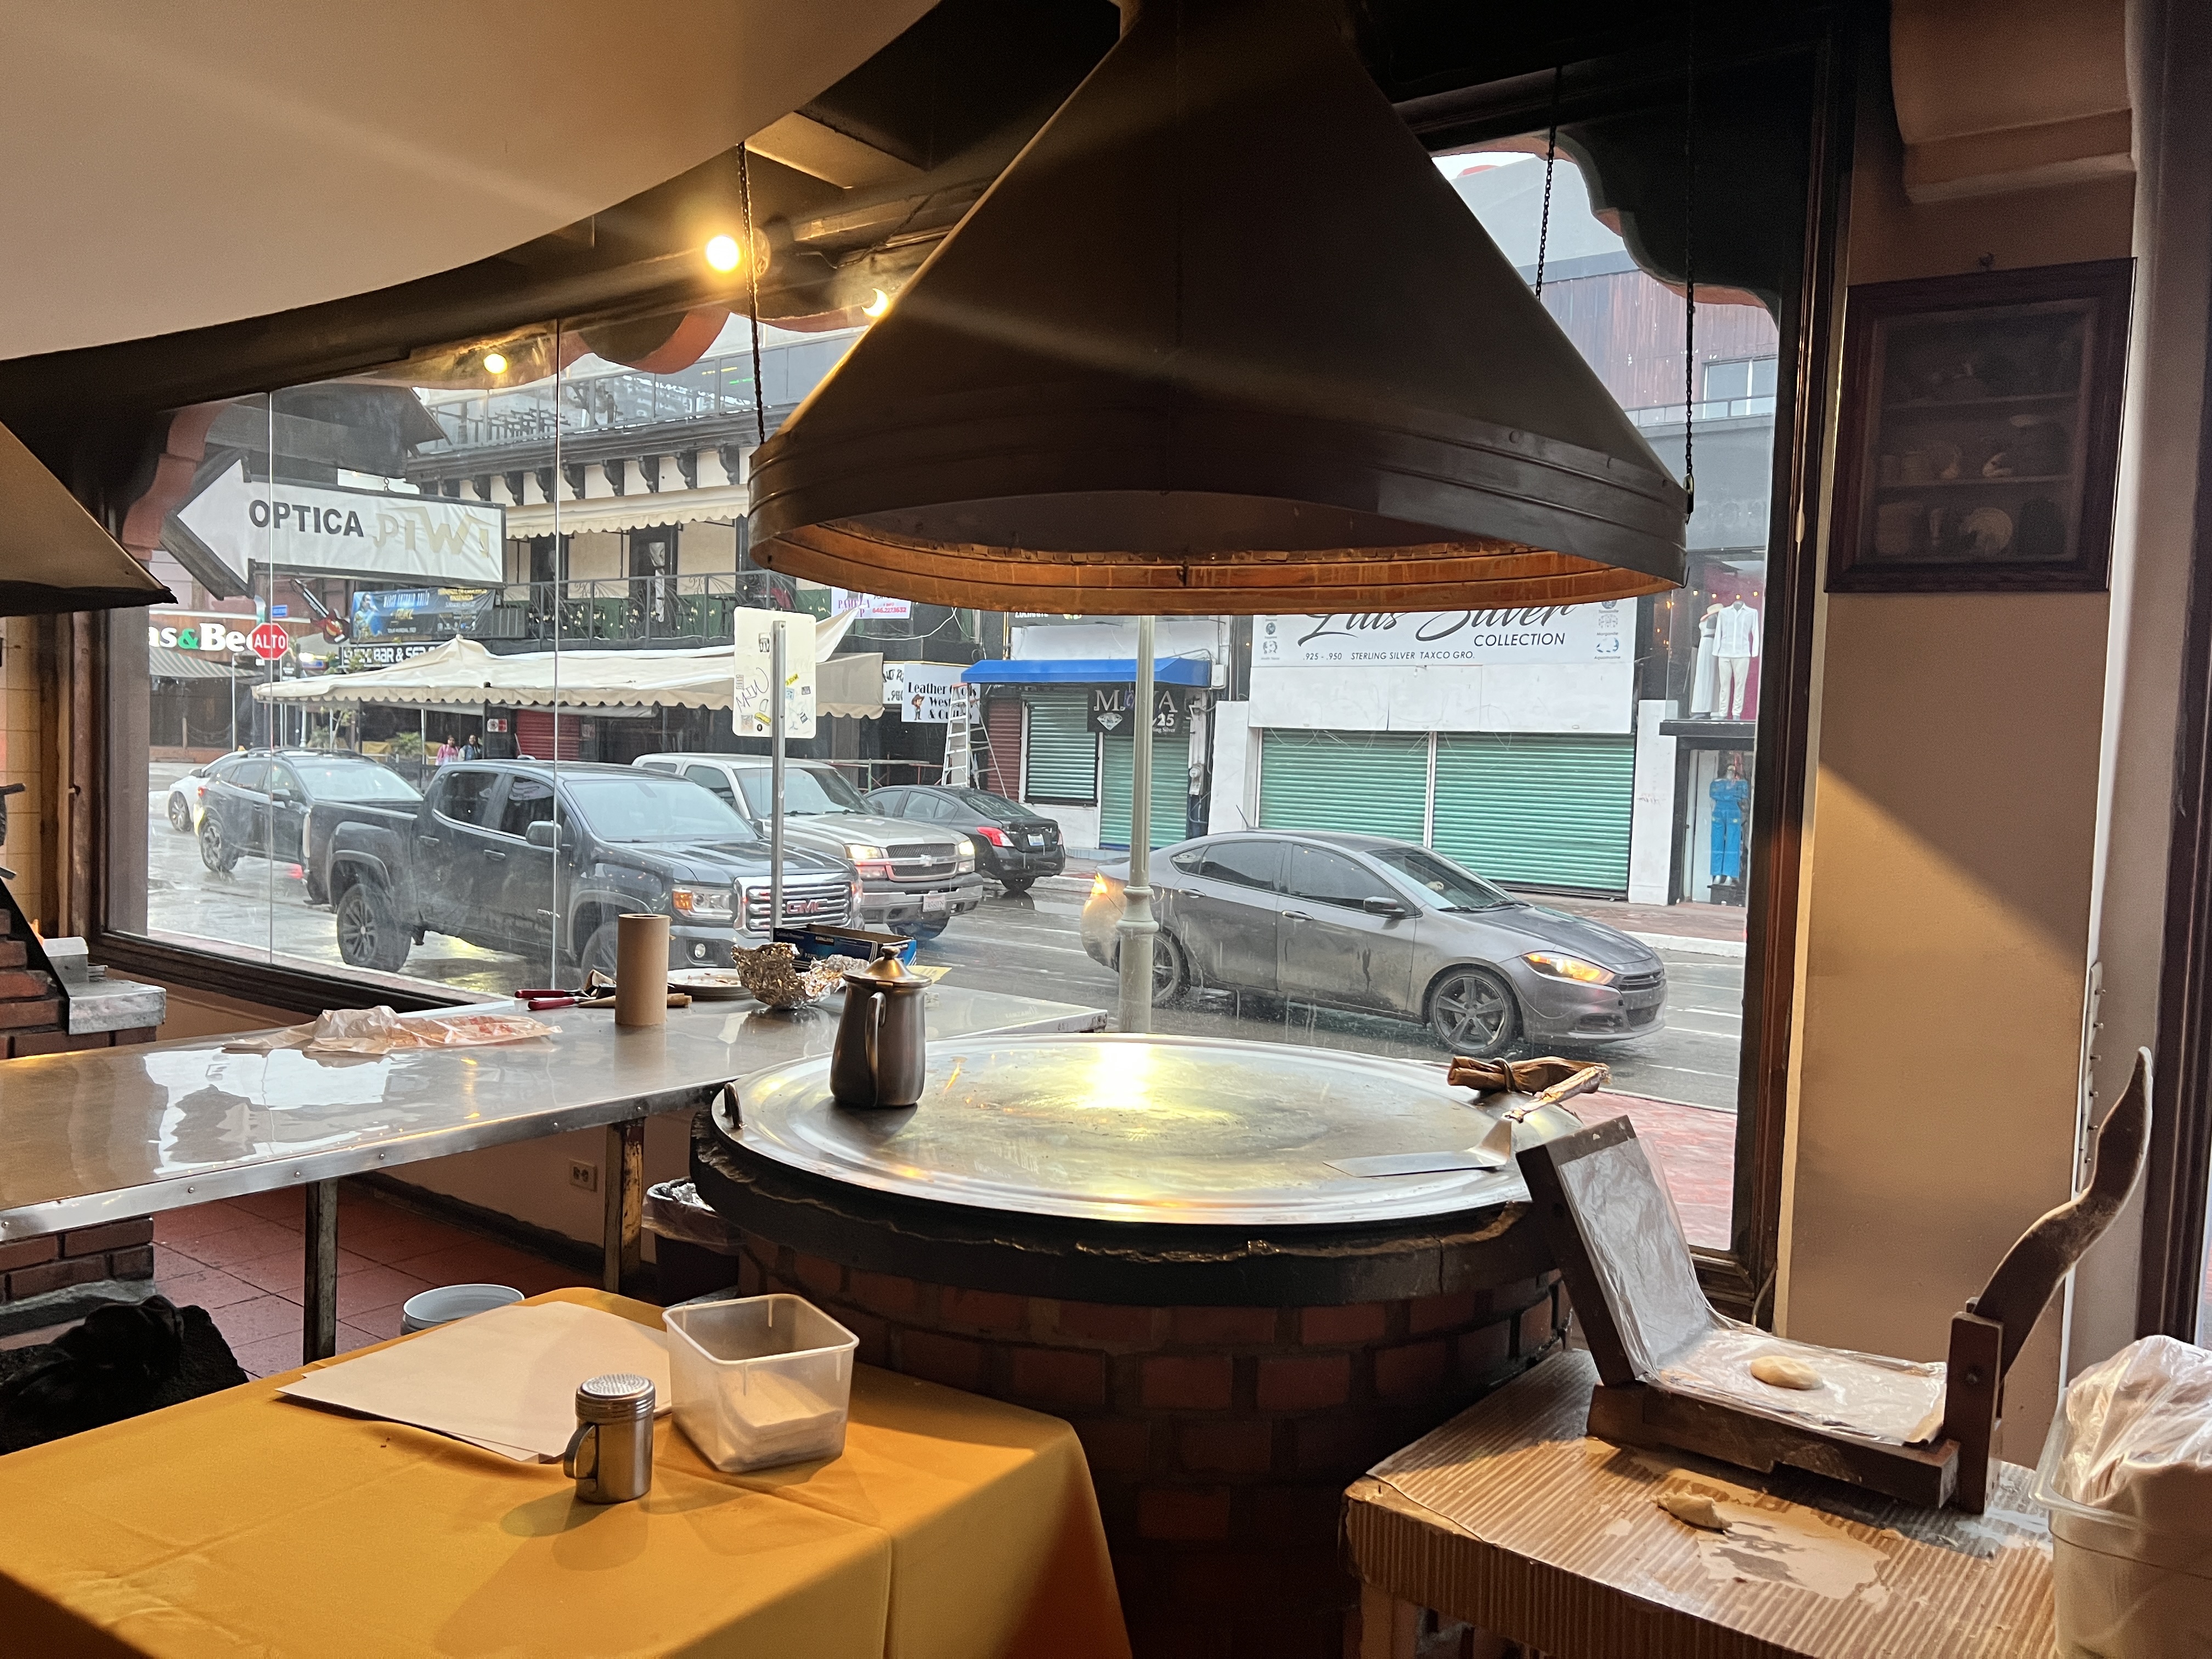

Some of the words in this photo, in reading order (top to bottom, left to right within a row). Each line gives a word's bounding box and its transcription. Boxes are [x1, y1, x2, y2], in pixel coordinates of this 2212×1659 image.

[249, 499, 364, 538] OPTICA
[254, 634, 286, 650] ALTO
[1474, 633, 1566, 647] COLLECTION
[1302, 653, 1318, 661] .925
[1326, 652, 1342, 661] .950
[1351, 652, 1387, 661] STERLING
[1389, 651, 1415, 660] SILVER
[1420, 651, 1450, 659] TAXCO
[1453, 651, 1476, 659] GRO.
[908, 681, 949, 695] Leather
[928, 709, 936, 720] &
[1152, 713, 1175, 727] 25
[786, 898, 828, 915] GMC
